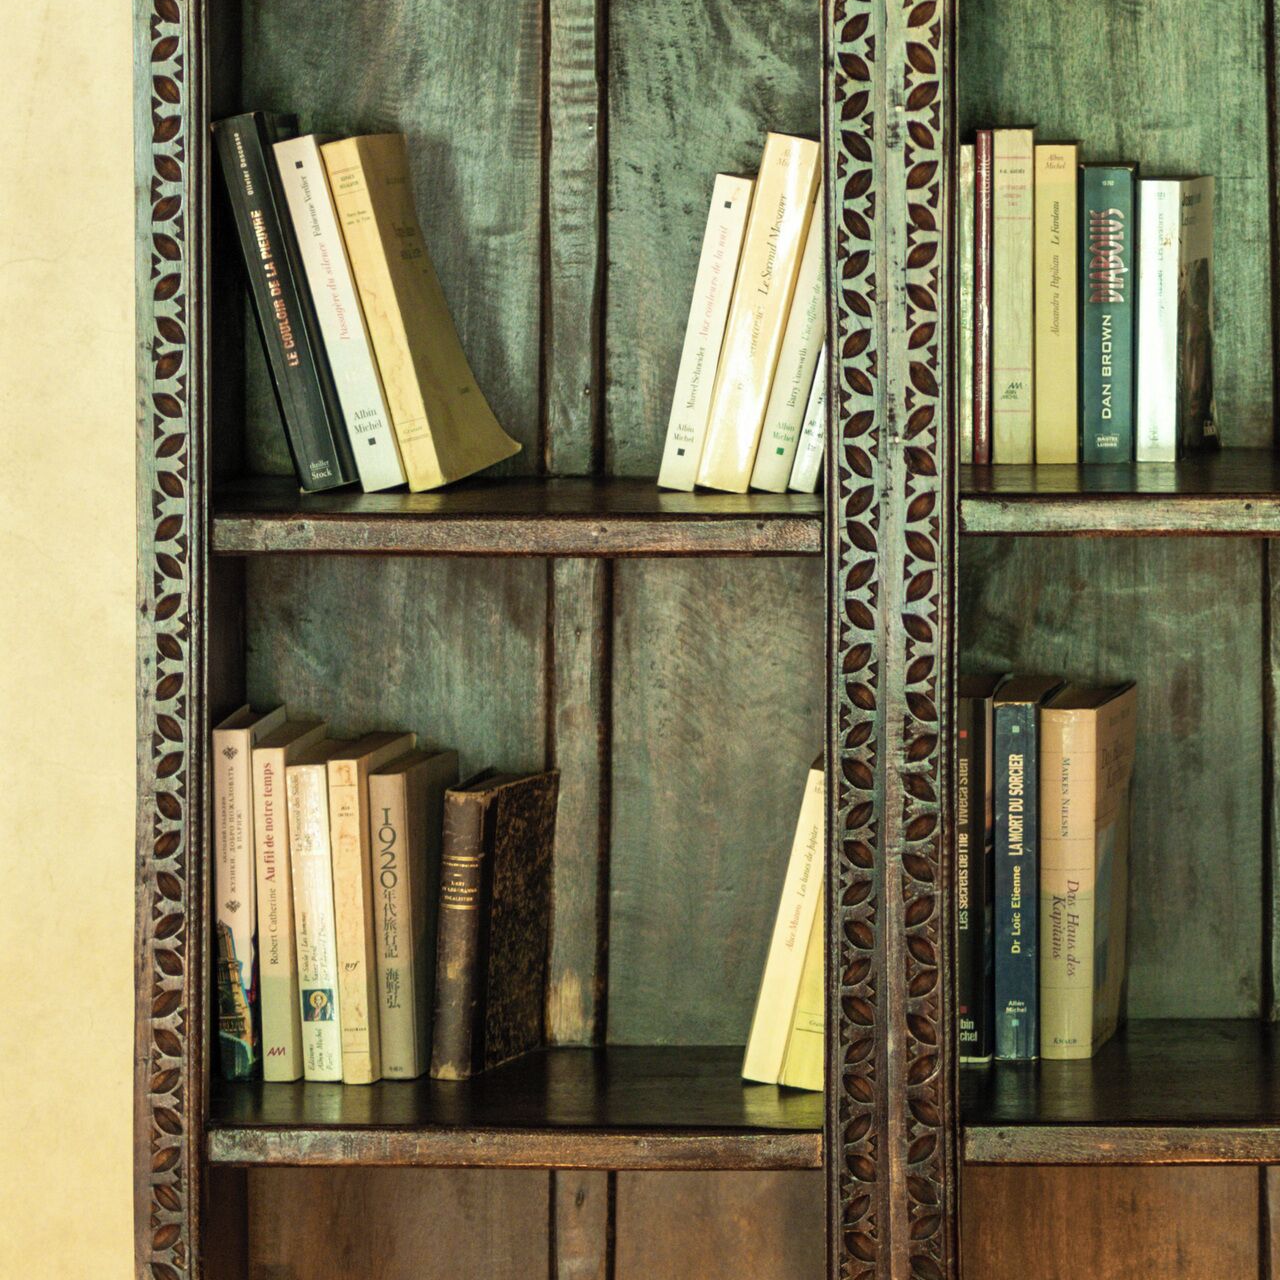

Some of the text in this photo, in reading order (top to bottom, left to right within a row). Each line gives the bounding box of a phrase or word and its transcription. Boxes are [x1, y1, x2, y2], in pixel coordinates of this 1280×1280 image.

[301, 175, 323, 238] Fabienne Verdier
[1051, 201, 1060, 246] Le Fardeau
[250, 209, 300, 367] LE COULOIR DE LA PIEUVRE
[1088, 208, 1129, 303] DIABOLUS
[319, 242, 351, 341] Passagère du silence
[686, 346, 706, 410] Marcel Schneider
[786, 346, 808, 408] Barry Unsworth
[1101, 314, 1113, 419] DAN BROWN
[353, 408, 383, 434] Albin Michel
[673, 423, 695, 443] Albin Michel
[772, 422, 795, 443] Albin Michel
[311, 468, 332, 480] Stock
[227, 766, 236, 823] ПОЖАЛОВАТЬ
[263, 762, 276, 881] Au fil de notre temps
[1008, 753, 1024, 856] LA MORT DU SORCIER
[1061, 757, 1071, 838] MAIKEN NIELSEN
[228, 825, 236, 852] ДОБРО
[268, 888, 279, 966] Robert Catherine
[1011, 865, 1021, 954] Dr Loïc Etienne
[1052, 895, 1067, 960] Kapitäns
[1067, 879, 1081, 977] Das Haus des
